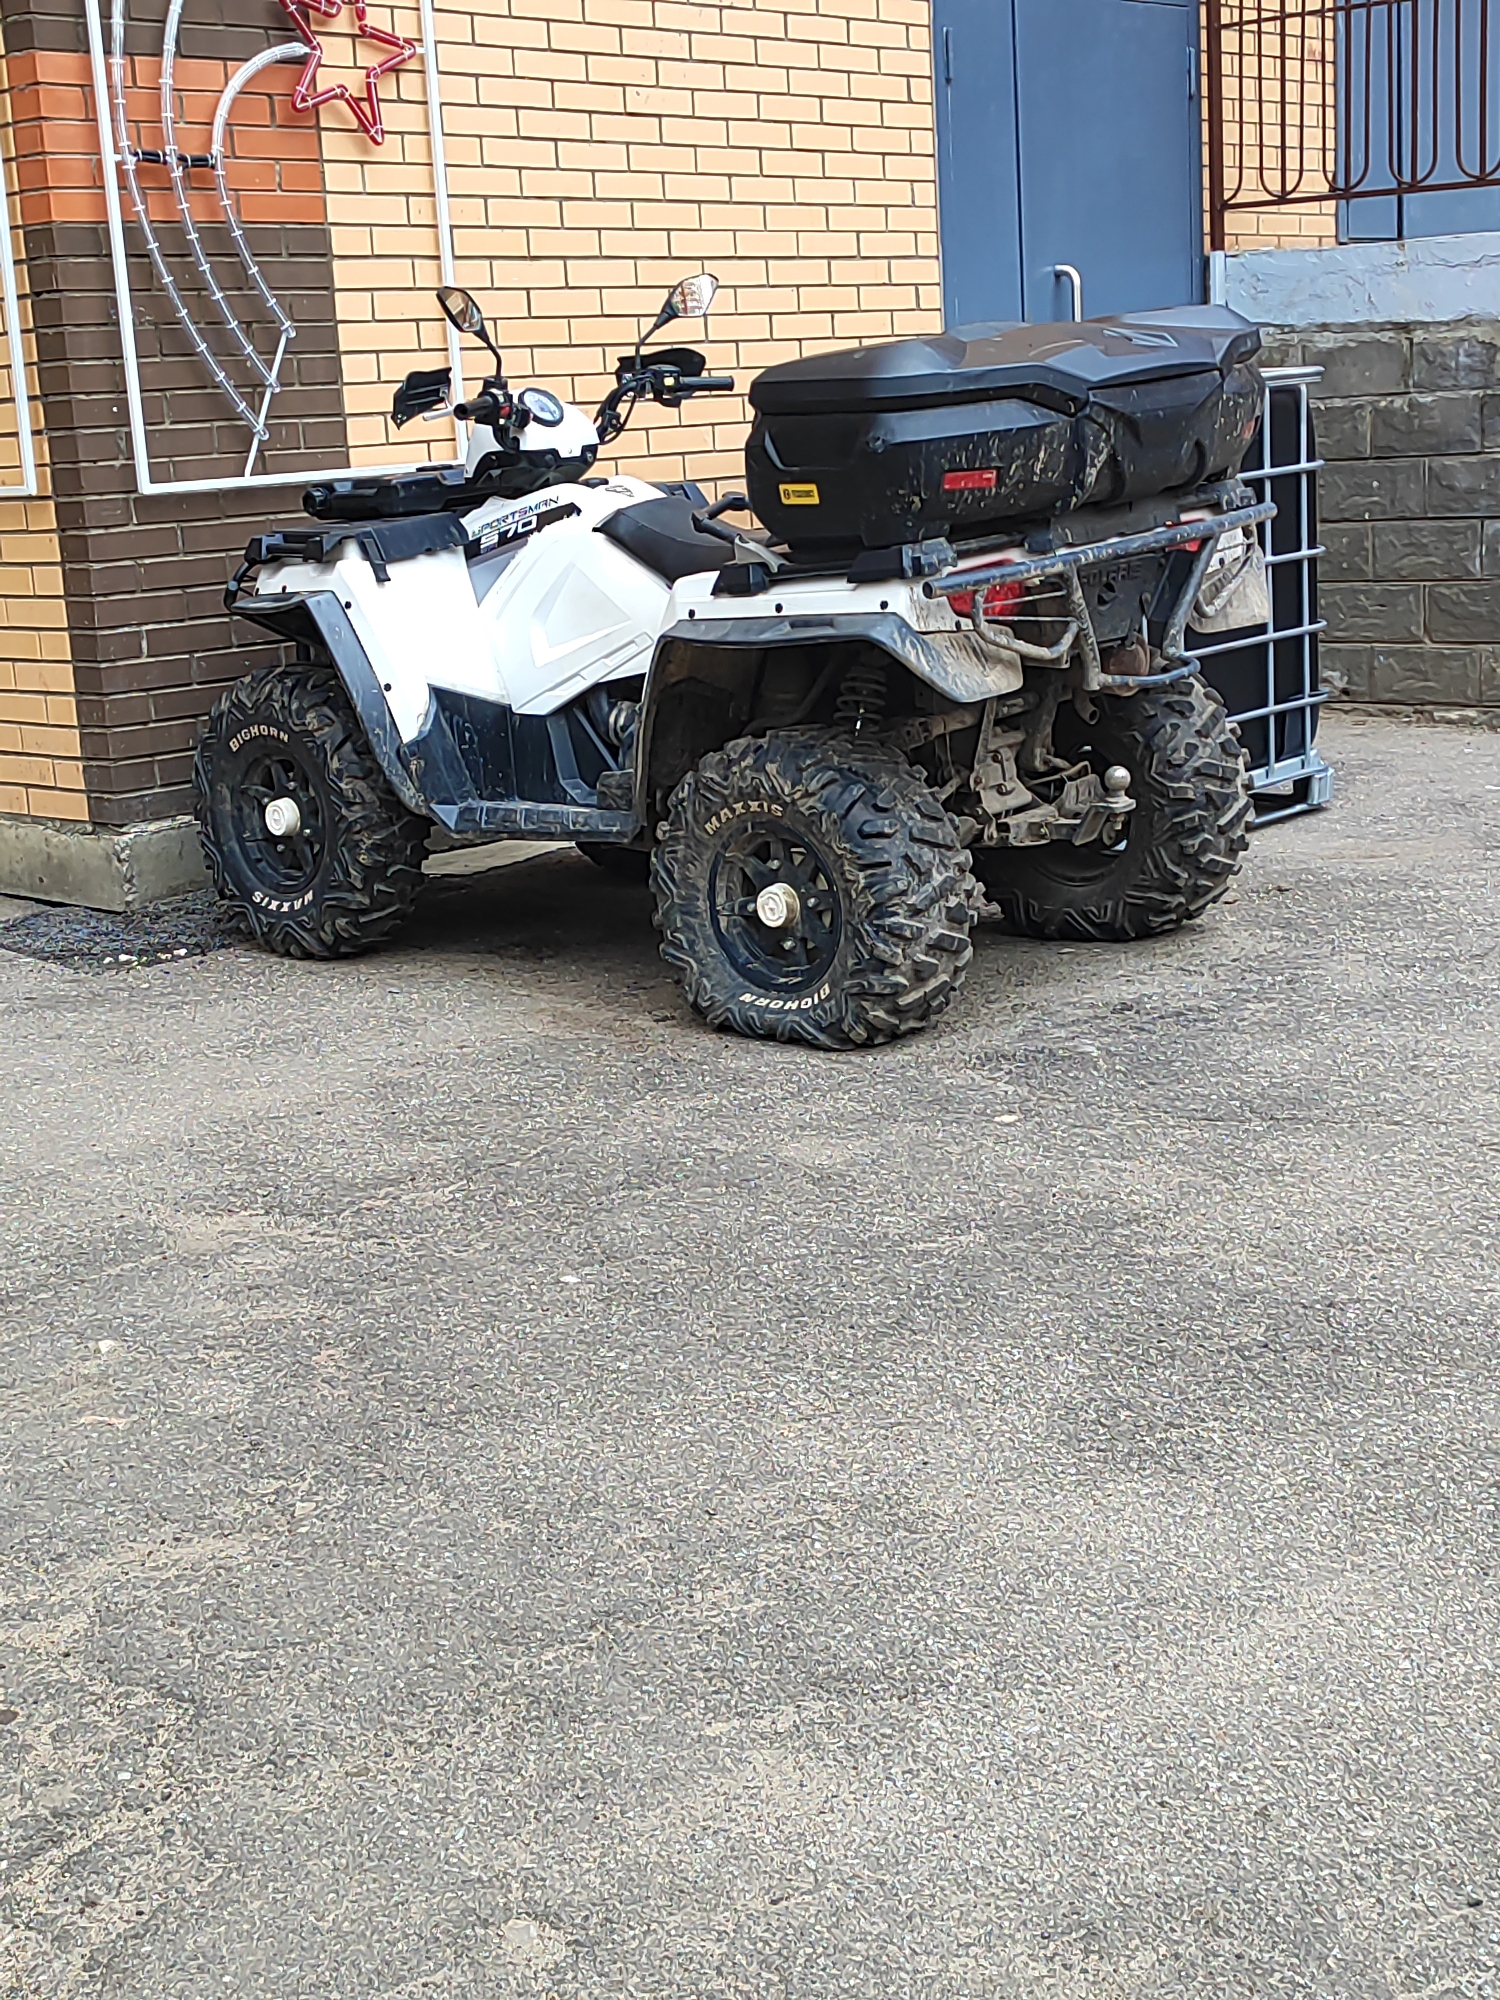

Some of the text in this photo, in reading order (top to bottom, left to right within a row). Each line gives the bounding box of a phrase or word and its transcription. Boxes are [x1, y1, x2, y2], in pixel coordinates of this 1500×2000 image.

[471, 496, 559, 538] SPORTSMAN
[480, 515, 537, 548] 570
[228, 724, 290, 752] BIGHORN
[704, 800, 784, 835] MAXXIS
[252, 889, 314, 913] MAXXIS
[738, 983, 831, 1010] BIGHORN
